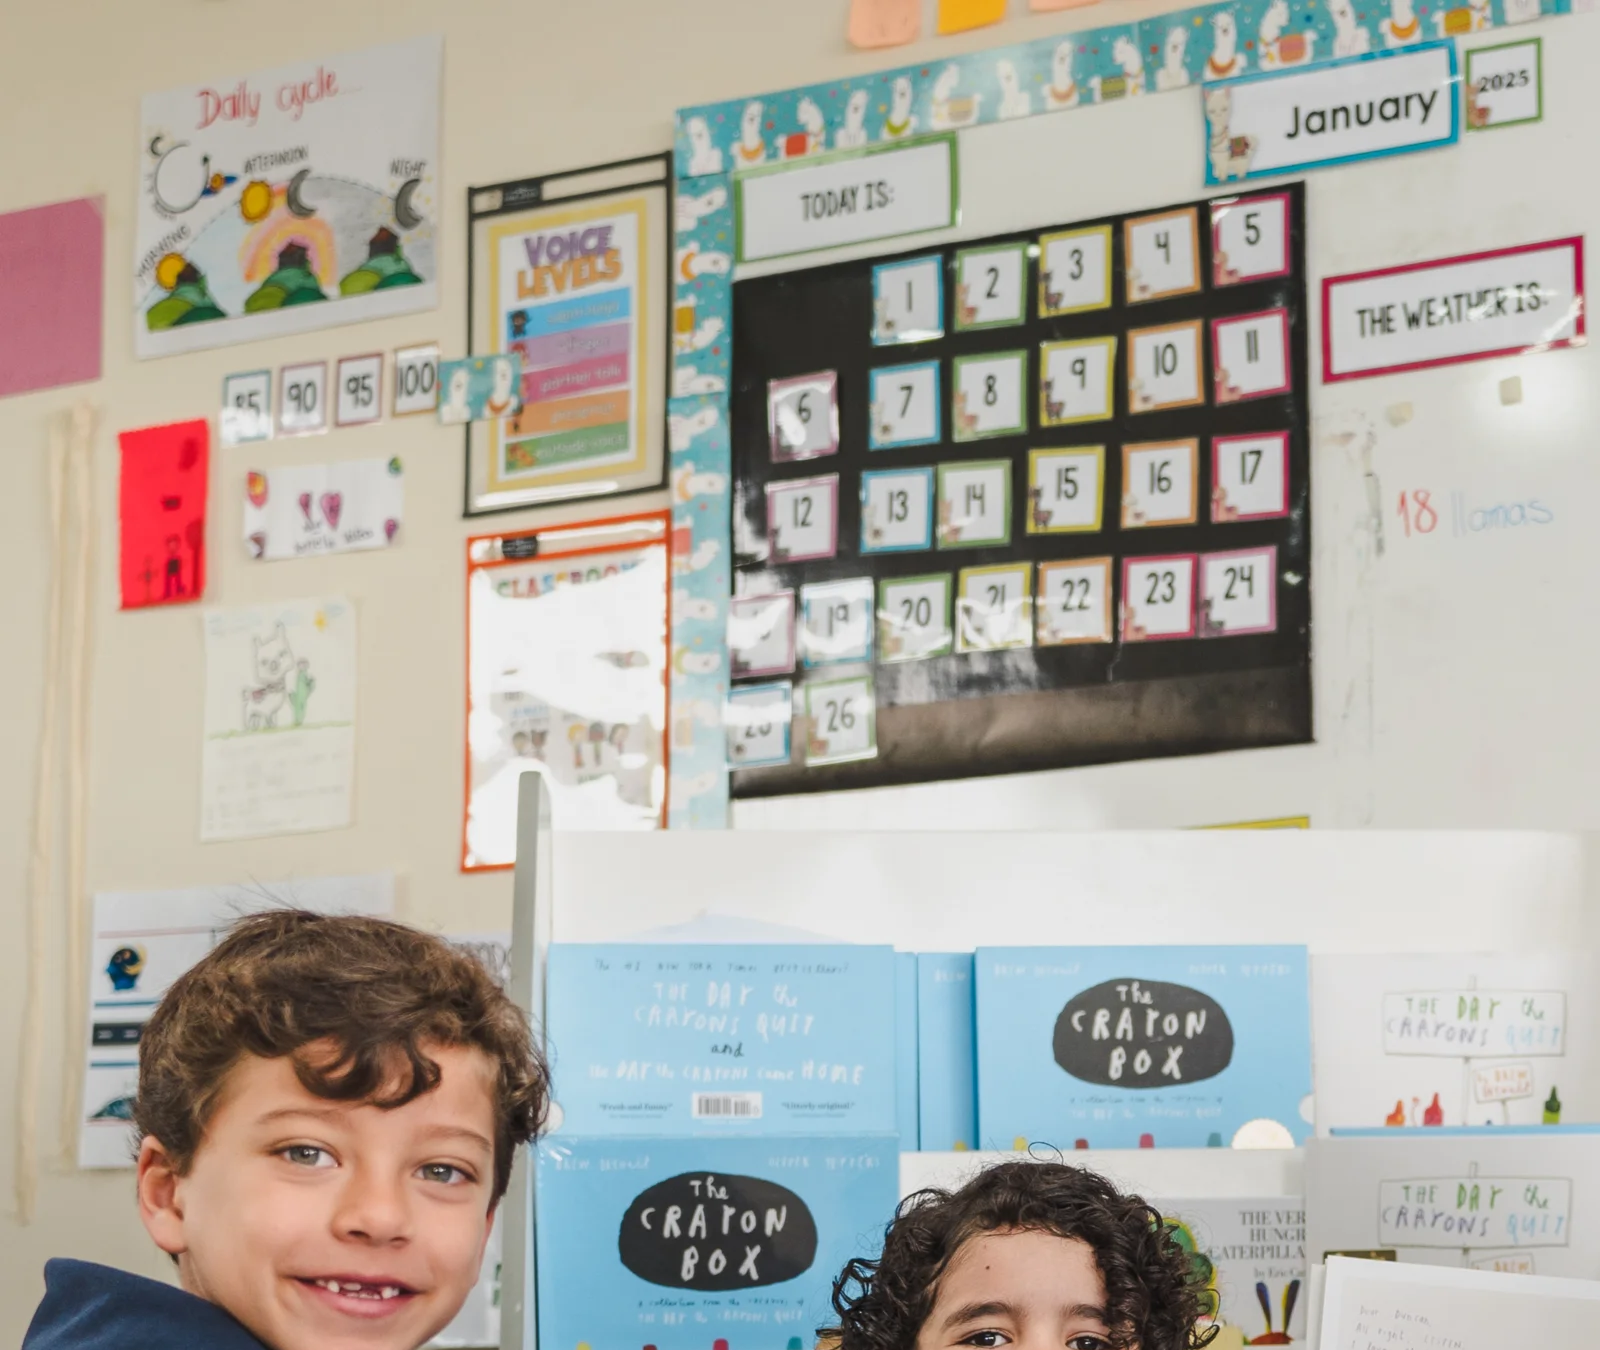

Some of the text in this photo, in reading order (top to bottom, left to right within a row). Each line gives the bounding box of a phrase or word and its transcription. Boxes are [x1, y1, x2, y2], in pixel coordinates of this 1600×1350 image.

[195, 66, 341, 130] Daily cycle
[1479, 70, 1530, 93] 2025
[1284, 89, 1440, 140] January
[799, 181, 896, 222] TODAY IS:
[523, 224, 614, 269] VOICE
[905, 213, 1263, 313] 1 2 3 4 5
[516, 247, 625, 302] LEVELS
[1356, 306, 1397, 338] THE
[1400, 285, 1508, 332] WEATHER
[286, 380, 317, 415] 90
[345, 373, 374, 409] 95
[398, 361, 436, 397] 100
[797, 329, 1261, 425] 6 7 8 9 10 11
[791, 449, 1264, 529] 12 13 14 15 16 17
[1395, 488, 1556, 539] 18 llamas
[901, 596, 932, 632] 20
[1061, 577, 1092, 613] 22
[1145, 570, 1176, 605] 23
[1223, 563, 1255, 600] 24
[825, 698, 857, 733] 26
[651, 979, 800, 1010] THE DAY the
[1115, 981, 1155, 1005] The
[1405, 995, 1547, 1022] THE DAY the
[632, 1003, 817, 1045] CRAYONS QUIT
[1070, 1007, 1209, 1042] CRAYON
[1386, 1015, 1562, 1053] CRAYONS QUIT
[709, 1041, 746, 1059] and
[1107, 1045, 1184, 1082] BOX
[615, 1058, 654, 1083] DAY
[681, 1063, 751, 1084] CRAYONS
[800, 1057, 867, 1087] HOME
[689, 1175, 729, 1201] The
[1401, 1182, 1550, 1213] THE DAY the
[640, 1203, 788, 1240] CRAYON
[1239, 1210, 1306, 1226] THE VER
[1250, 1227, 1306, 1242] HUNGR
[1381, 1204, 1566, 1246] CRAYONS QUIT
[680, 1244, 762, 1282] BOX
[1210, 1245, 1306, 1260] CATERPILLA
